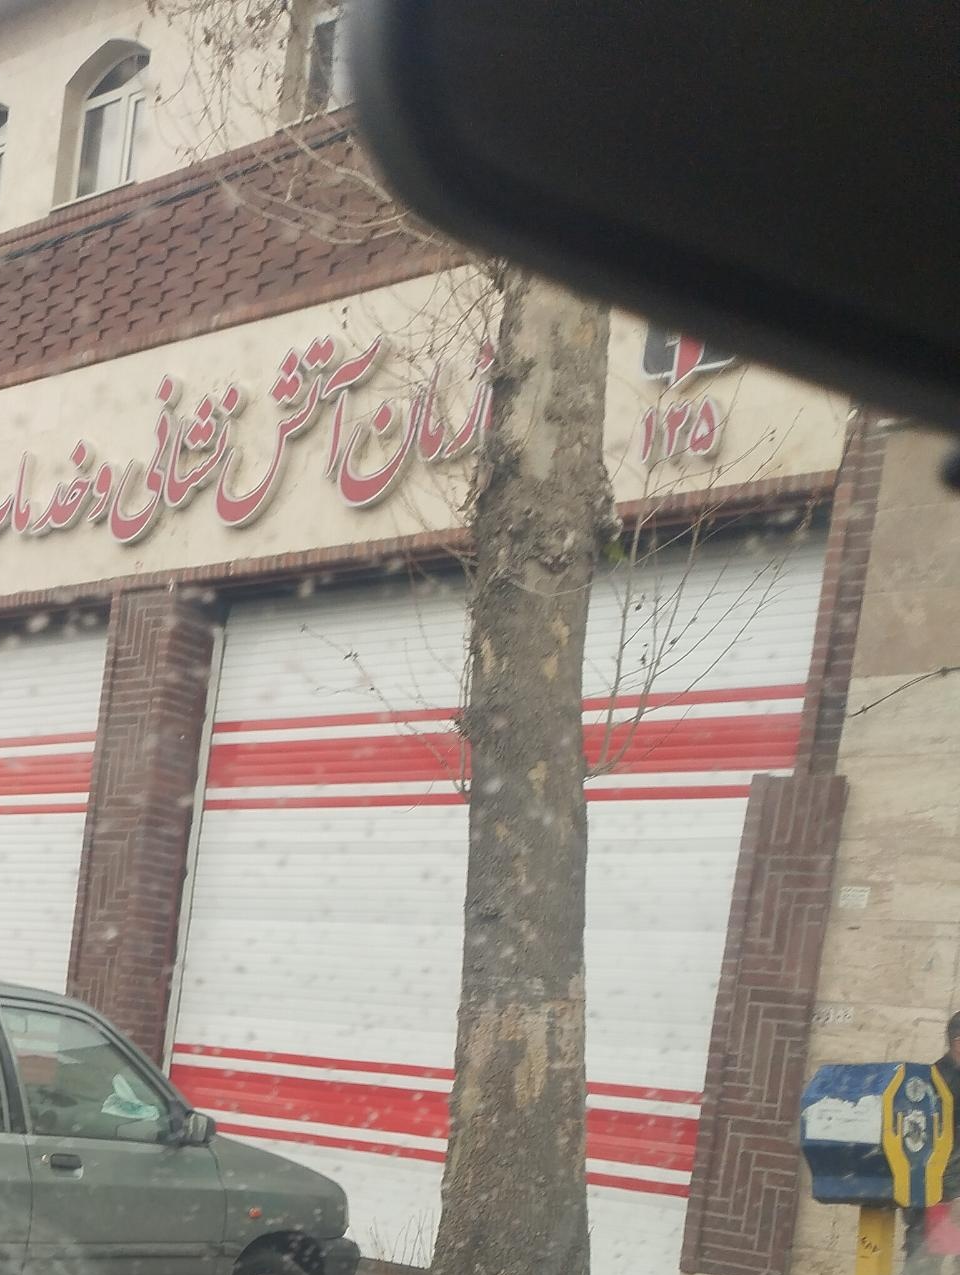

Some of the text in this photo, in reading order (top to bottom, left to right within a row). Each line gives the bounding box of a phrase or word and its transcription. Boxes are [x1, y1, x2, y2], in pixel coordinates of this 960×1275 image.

[109, 374, 240, 543] نشانی
[215, 334, 383, 527] آتش
[640, 395, 717, 464] ۱۲۵
